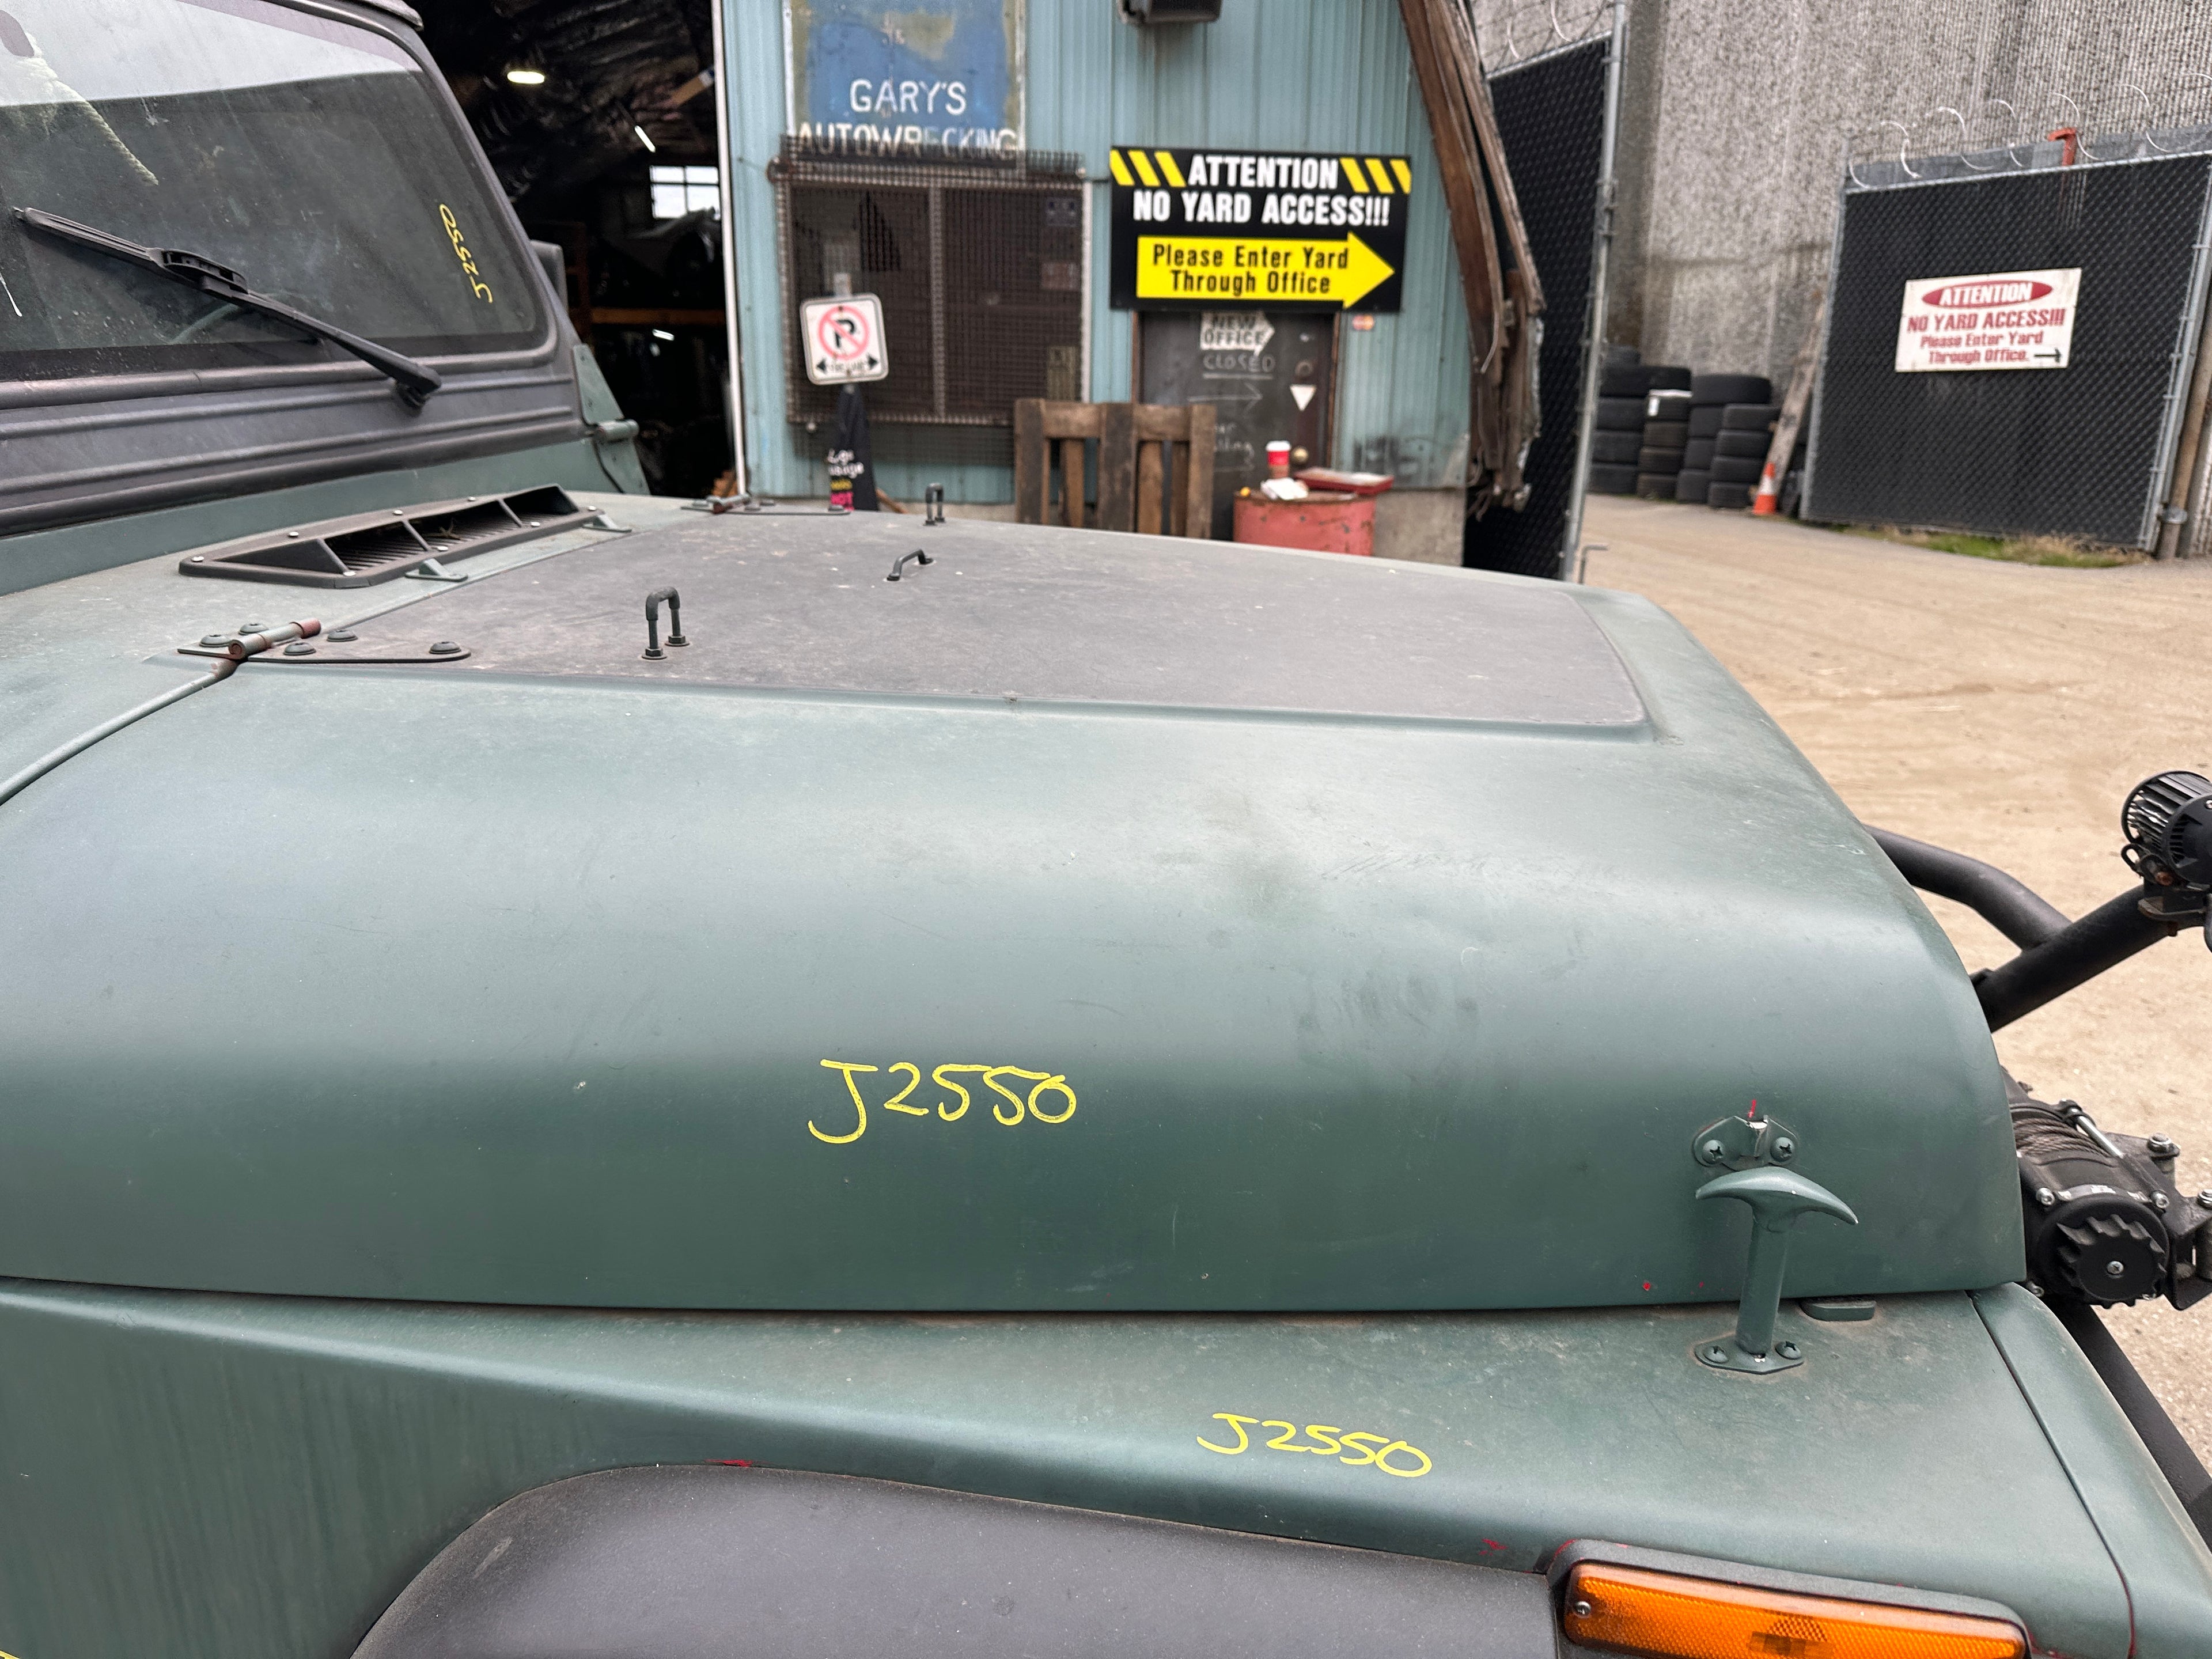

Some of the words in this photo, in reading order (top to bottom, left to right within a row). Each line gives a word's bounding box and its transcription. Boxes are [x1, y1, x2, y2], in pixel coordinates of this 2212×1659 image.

[850, 78, 967, 115] GARY'S
[1188, 154, 1339, 190] ATTENTION
[1133, 189, 1171, 221] NO
[1181, 191, 1251, 224] YARD
[1261, 193, 1390, 226] ACCESS!!!
[438, 203, 493, 304] J2550
[1153, 243, 1224, 267] Please
[1234, 245, 1291, 268] Enter
[1302, 246, 1349, 269] Yard
[1171, 269, 1256, 297] Through
[1267, 270, 1331, 293] Office
[1939, 282, 2033, 306] ATTENTION
[1907, 316, 1929, 333] NO
[1934, 313, 1979, 331] YARD
[1982, 308, 2066, 329] ACCESS!!!
[1204, 328, 1266, 346] OFFICE
[1920, 335, 1962, 349] Please
[1965, 332, 2003, 346] Enter
[2009, 330, 2044, 345] Yard
[1929, 350, 1980, 365] Through
[808, 1059, 1077, 1145] J2550
[1196, 1412, 1433, 1478] J2550
